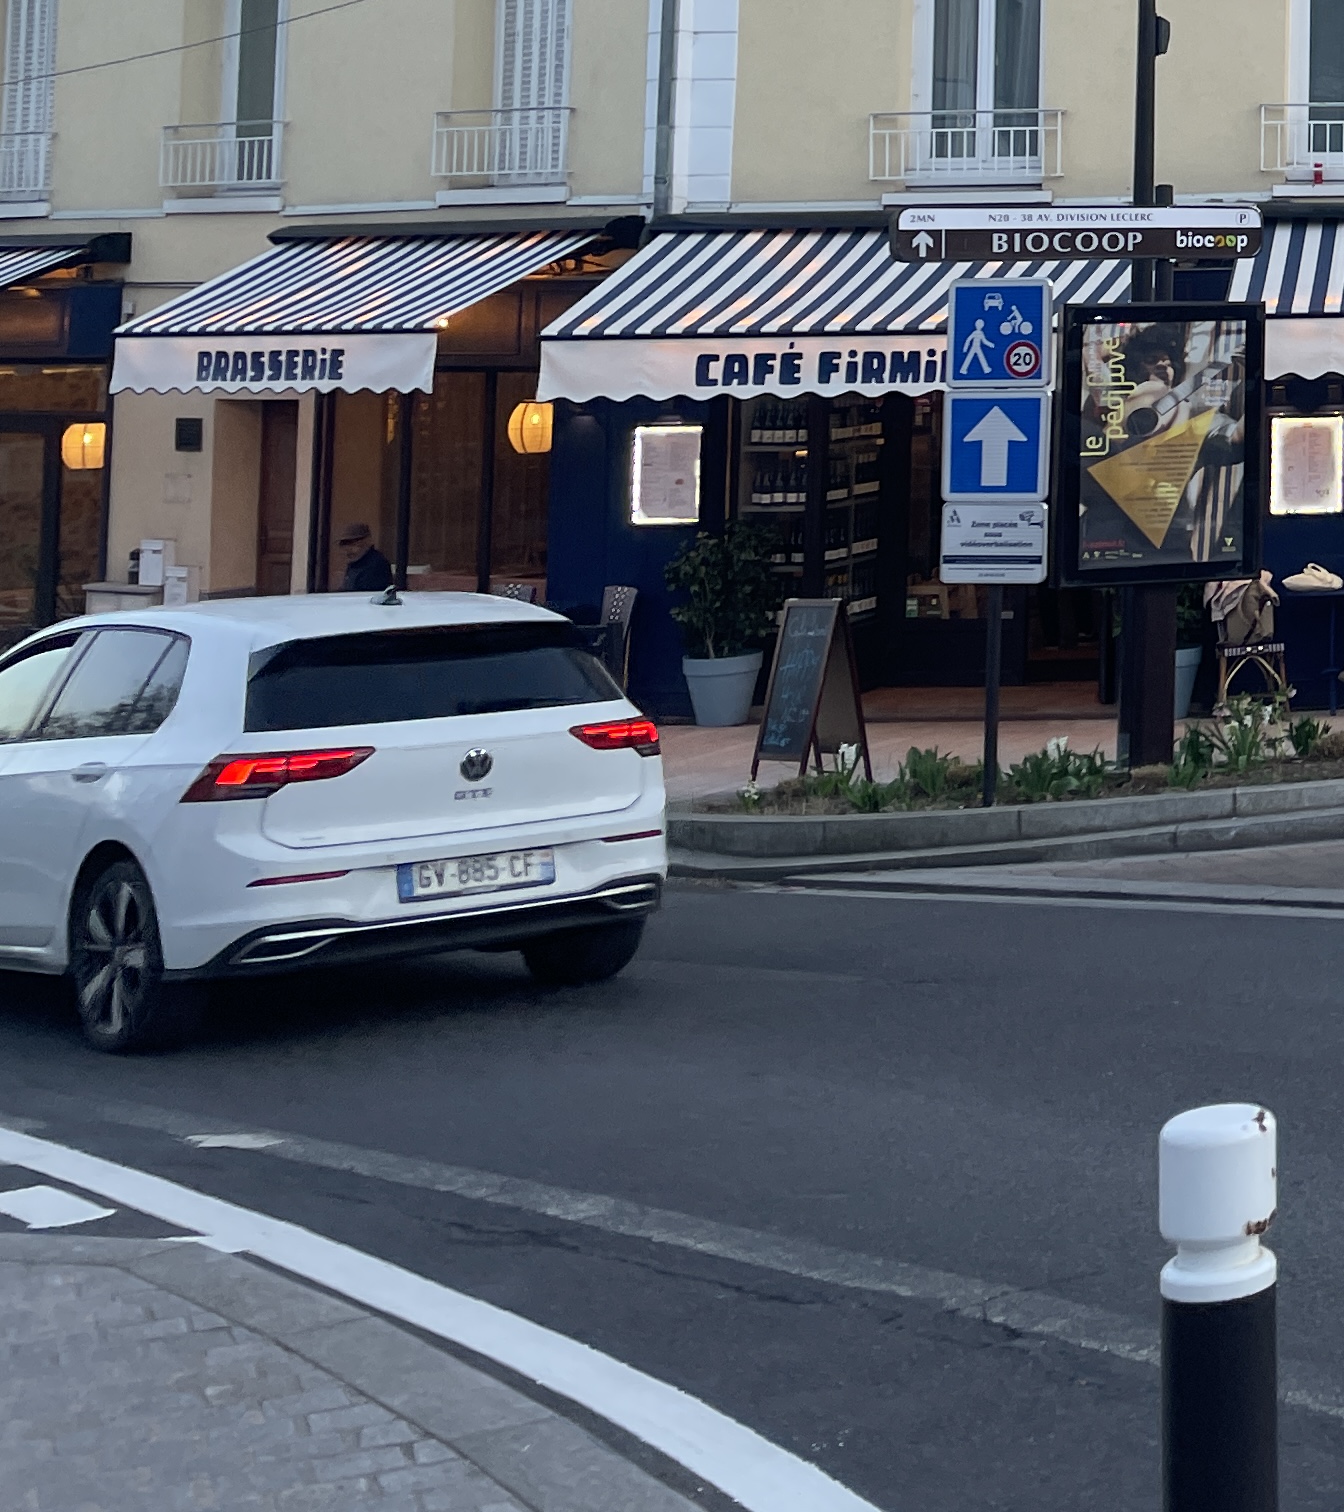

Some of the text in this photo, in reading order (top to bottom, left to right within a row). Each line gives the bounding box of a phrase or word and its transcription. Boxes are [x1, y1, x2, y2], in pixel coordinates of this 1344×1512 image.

[909, 214, 936, 223] 2MN
[1056, 213, 1108, 222] DIVISION
[1110, 213, 1155, 222] LECLERC
[991, 232, 1144, 253] BIOCOOP
[1176, 230, 1248, 253] biocoop
[695, 341, 804, 386] CAFÉ
[1012, 352, 1032, 367] 20
